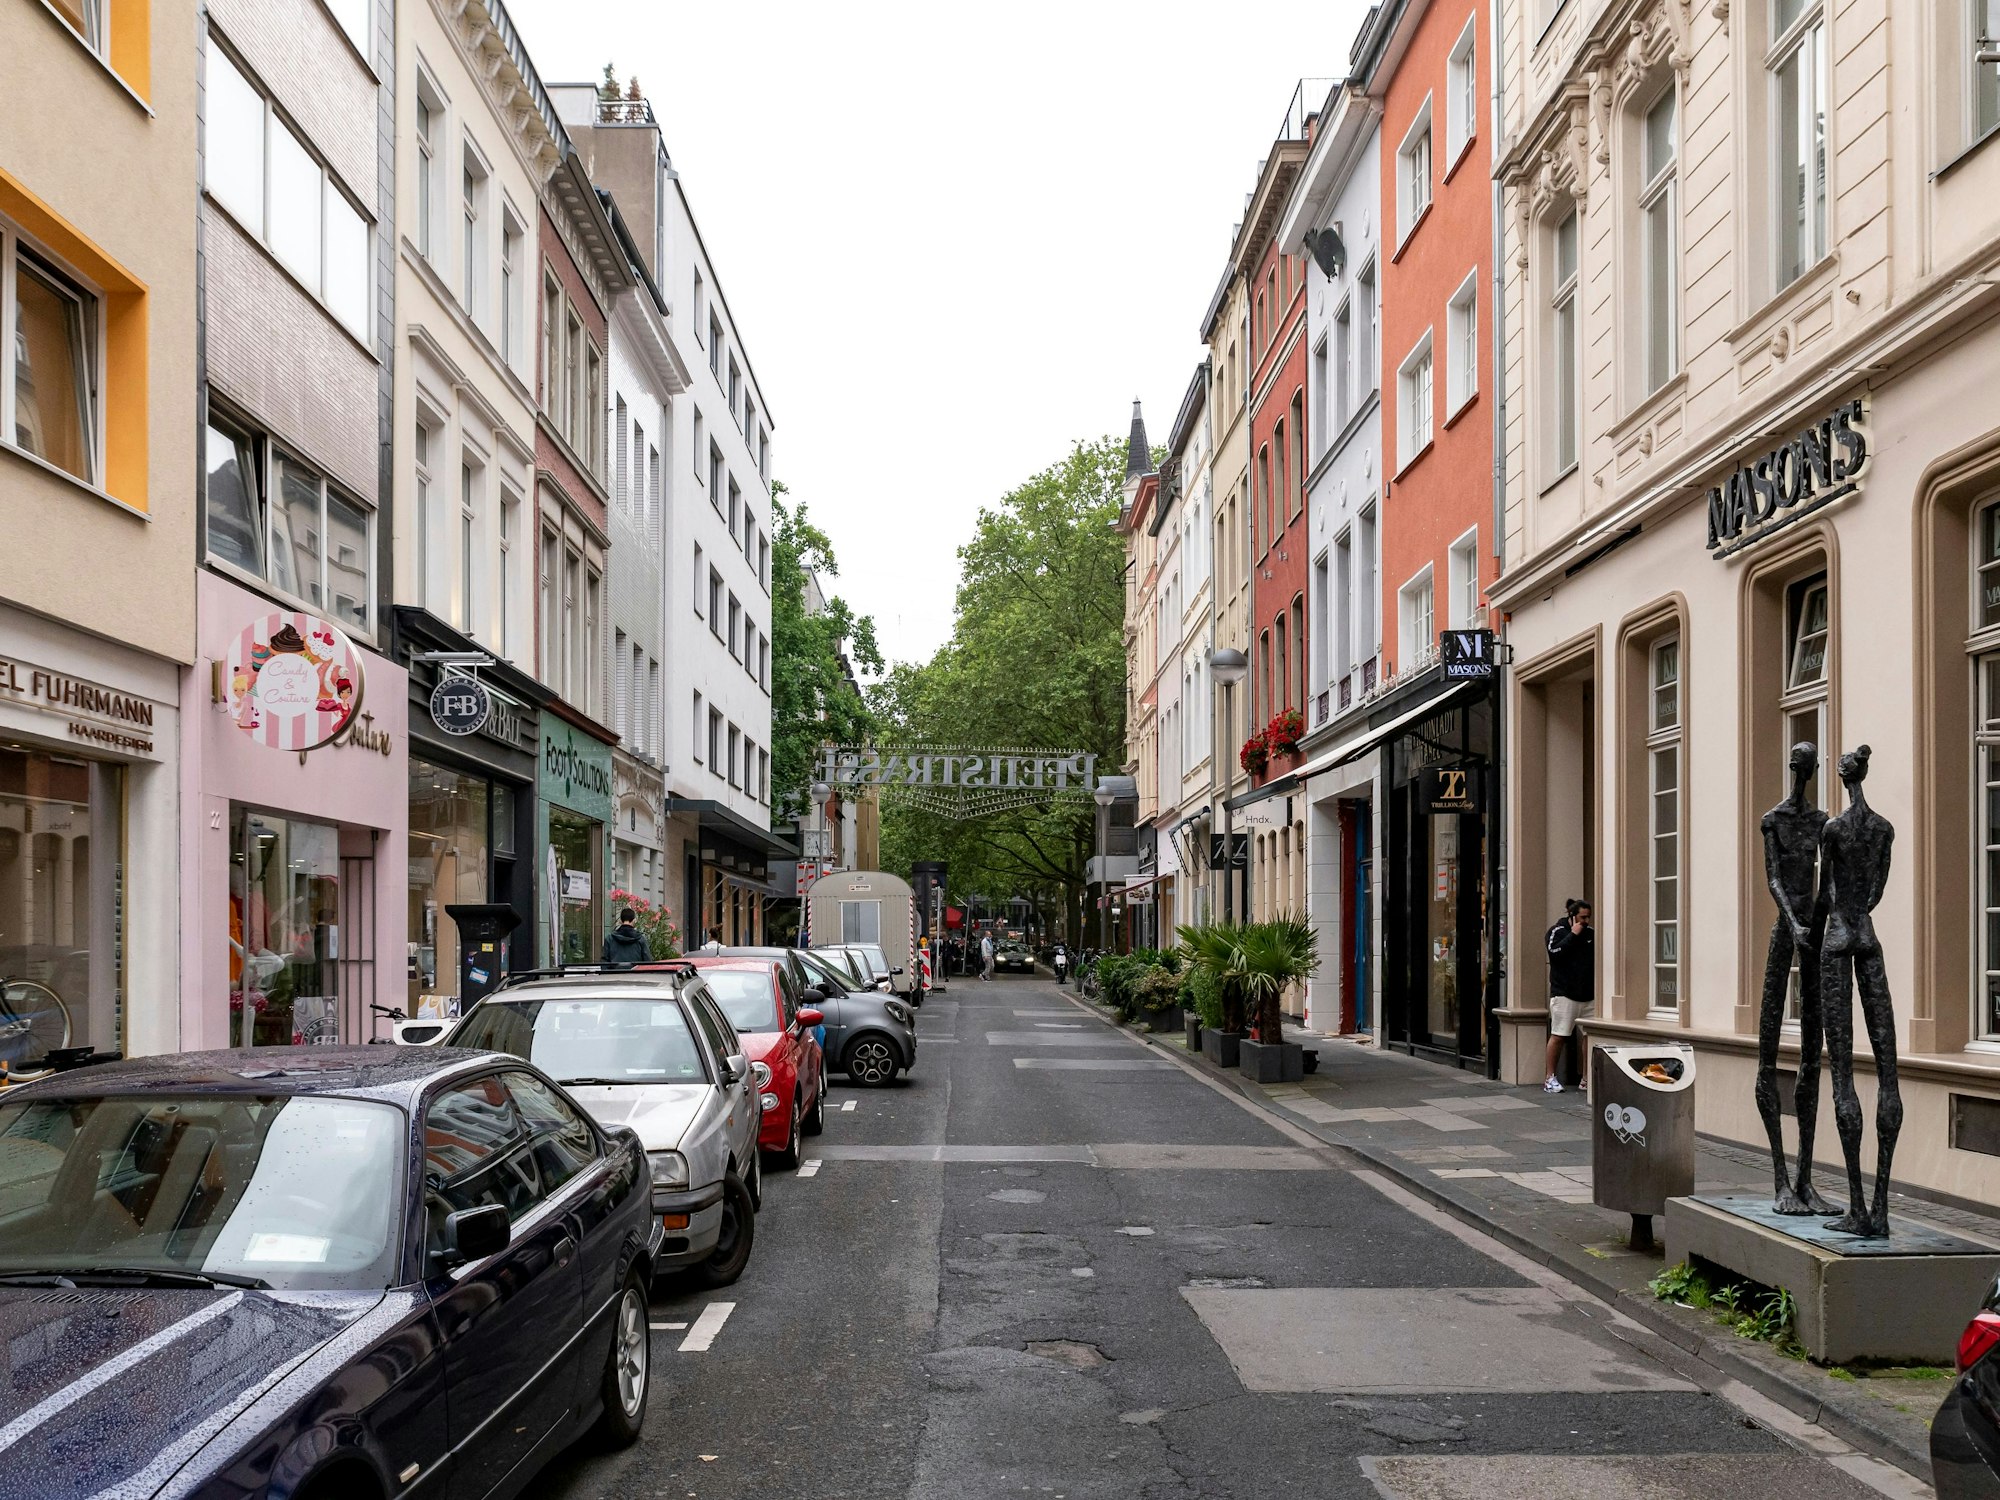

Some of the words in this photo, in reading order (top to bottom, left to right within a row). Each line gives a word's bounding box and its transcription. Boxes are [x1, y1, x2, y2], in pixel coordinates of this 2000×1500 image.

[1456, 633, 1482, 658] M
[267, 660, 308, 683] Candy
[284, 678, 295, 690] &
[32, 671, 153, 726] FUHRMANN
[264, 688, 311, 704] Couture
[441, 695, 478, 717] F&B
[69, 722, 153, 752] HAARDESIGN
[210, 811, 220, 829] 22
[1245, 815, 1272, 824] Hndx.
